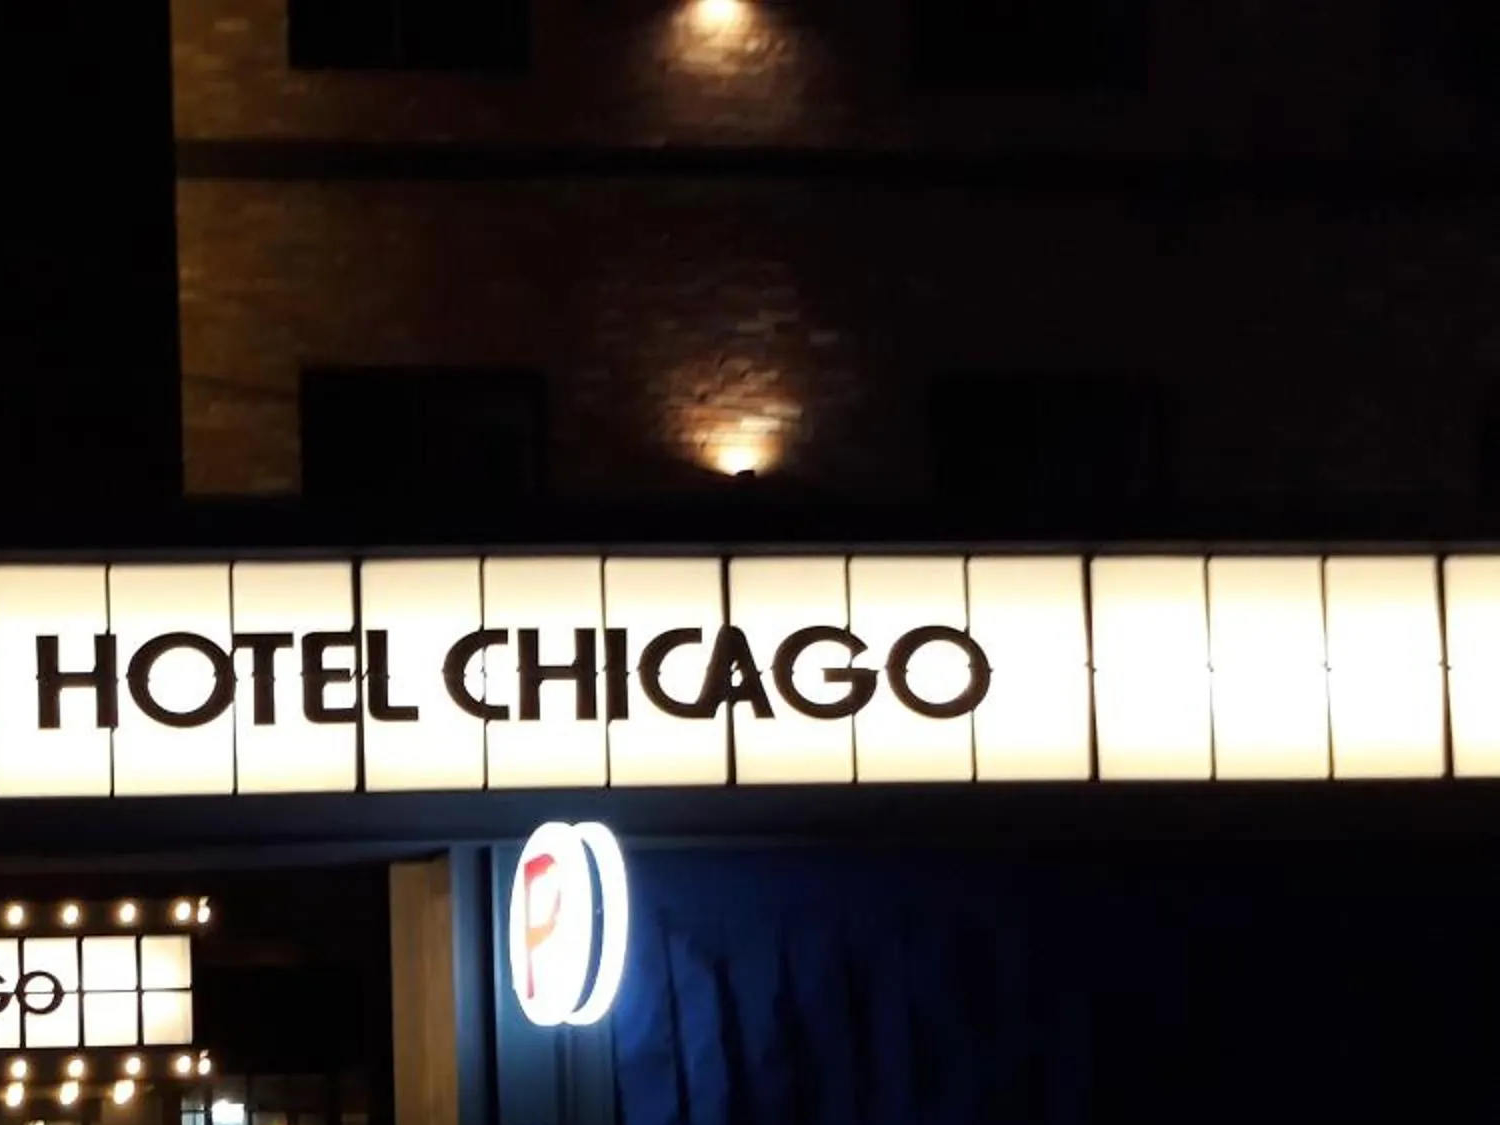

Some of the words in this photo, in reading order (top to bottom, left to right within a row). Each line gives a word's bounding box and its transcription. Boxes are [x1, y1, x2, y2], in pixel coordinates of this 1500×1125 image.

[35, 628, 419, 730] HOTEL
[443, 623, 993, 722] CHICAGO
[523, 852, 562, 1000] P
